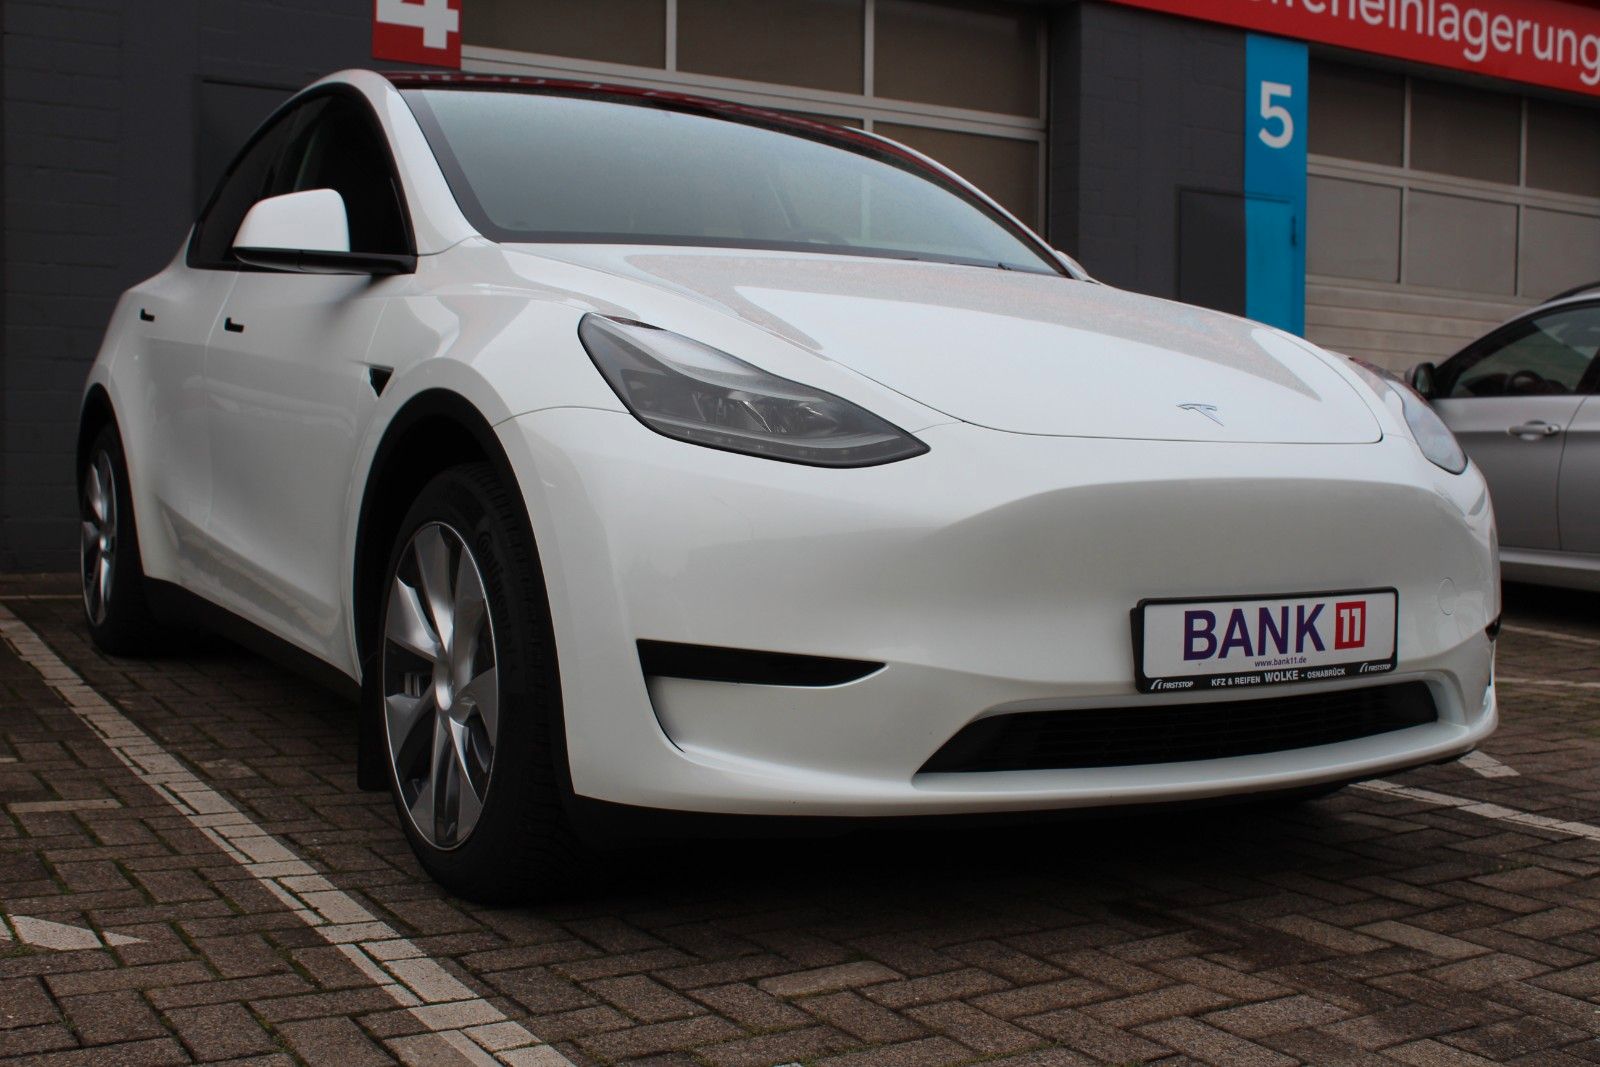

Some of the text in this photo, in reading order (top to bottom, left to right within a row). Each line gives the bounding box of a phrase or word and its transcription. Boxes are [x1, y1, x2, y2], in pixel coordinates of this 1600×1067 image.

[1249, 0, 1600, 86] einlagerung
[1258, 81, 1295, 149] 5
[1183, 604, 1361, 661] BANK 11
[1211, 678, 1226, 687] KFZ
[1234, 675, 1261, 685] REIFEN
[1264, 670, 1299, 683] WOLKE
[1307, 667, 1346, 679] OSNABRÜCK
[1254, 656, 1307, 668] www.bank11.de
